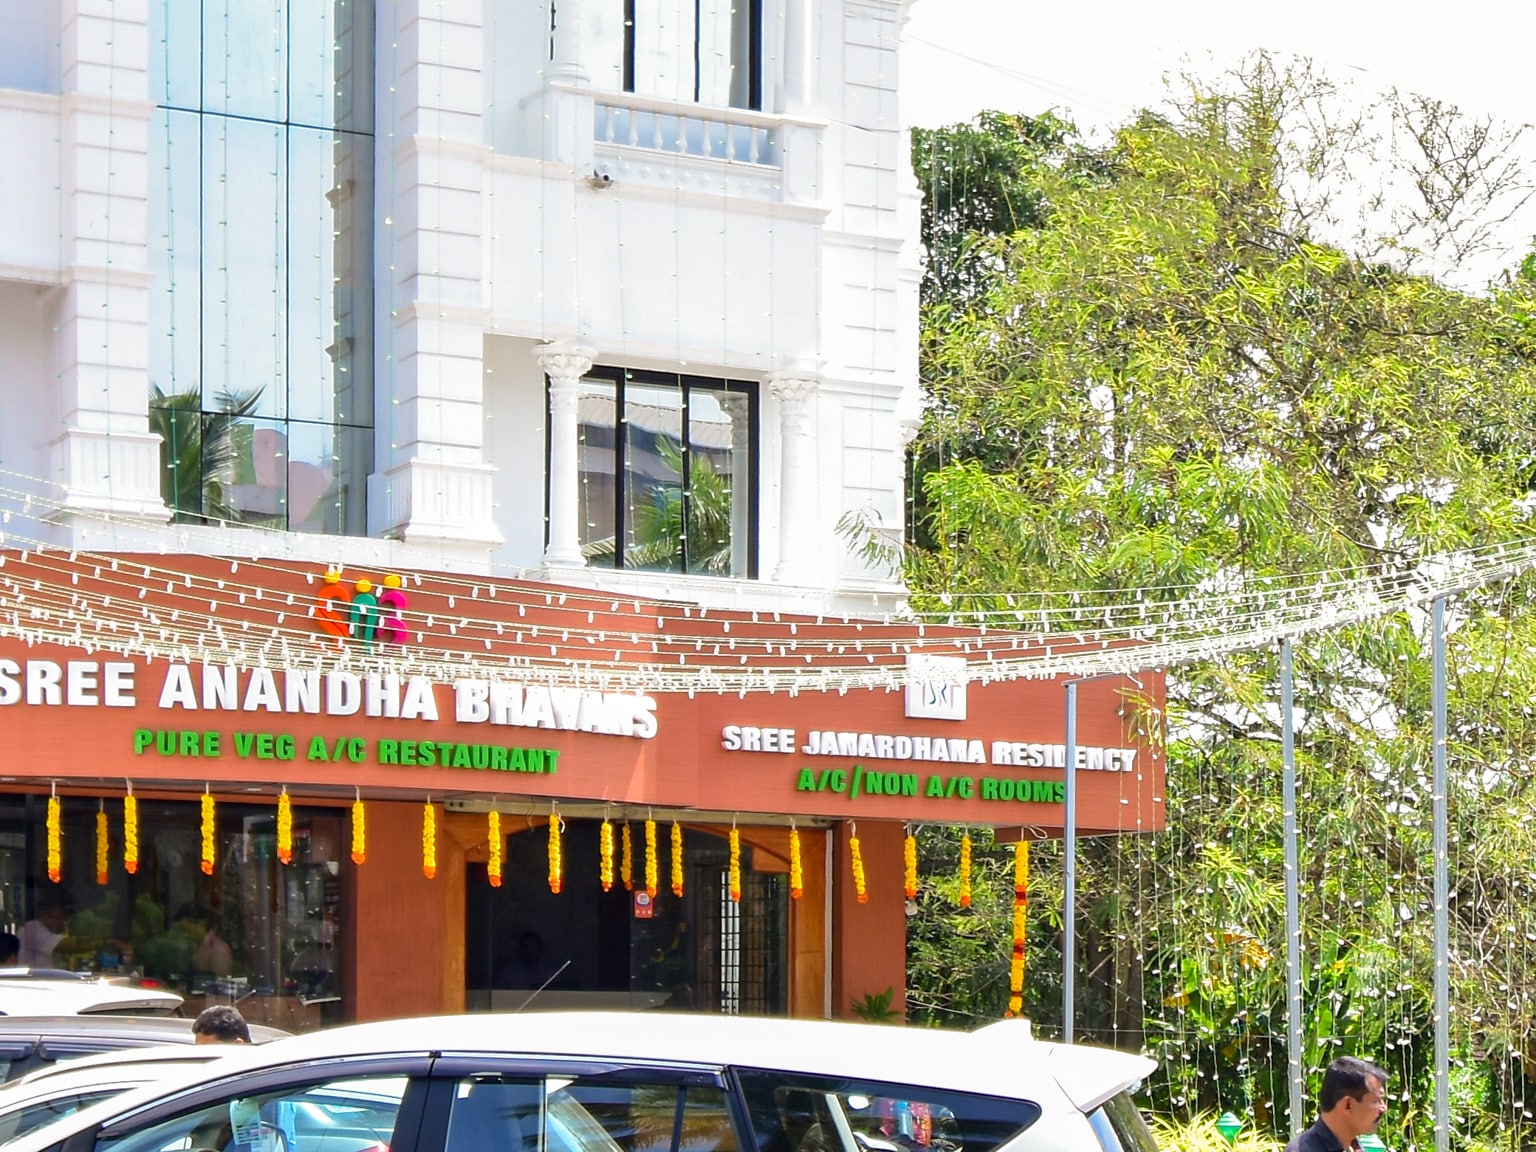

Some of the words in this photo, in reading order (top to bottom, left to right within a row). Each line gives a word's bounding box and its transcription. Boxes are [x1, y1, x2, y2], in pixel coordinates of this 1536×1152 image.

[0, 658, 137, 707] SREE
[158, 662, 440, 722] ANANDHA
[455, 678, 658, 739] BHAVANS
[134, 728, 221, 758] PURE
[233, 732, 295, 761] VEG
[308, 735, 367, 763] A/C
[378, 738, 560, 775] RESTAURANT
[721, 724, 796, 754] SREE
[802, 730, 987, 764] JANARDHANA
[926, 775, 974, 799] A/C
[981, 777, 1066, 803] ROOMS
